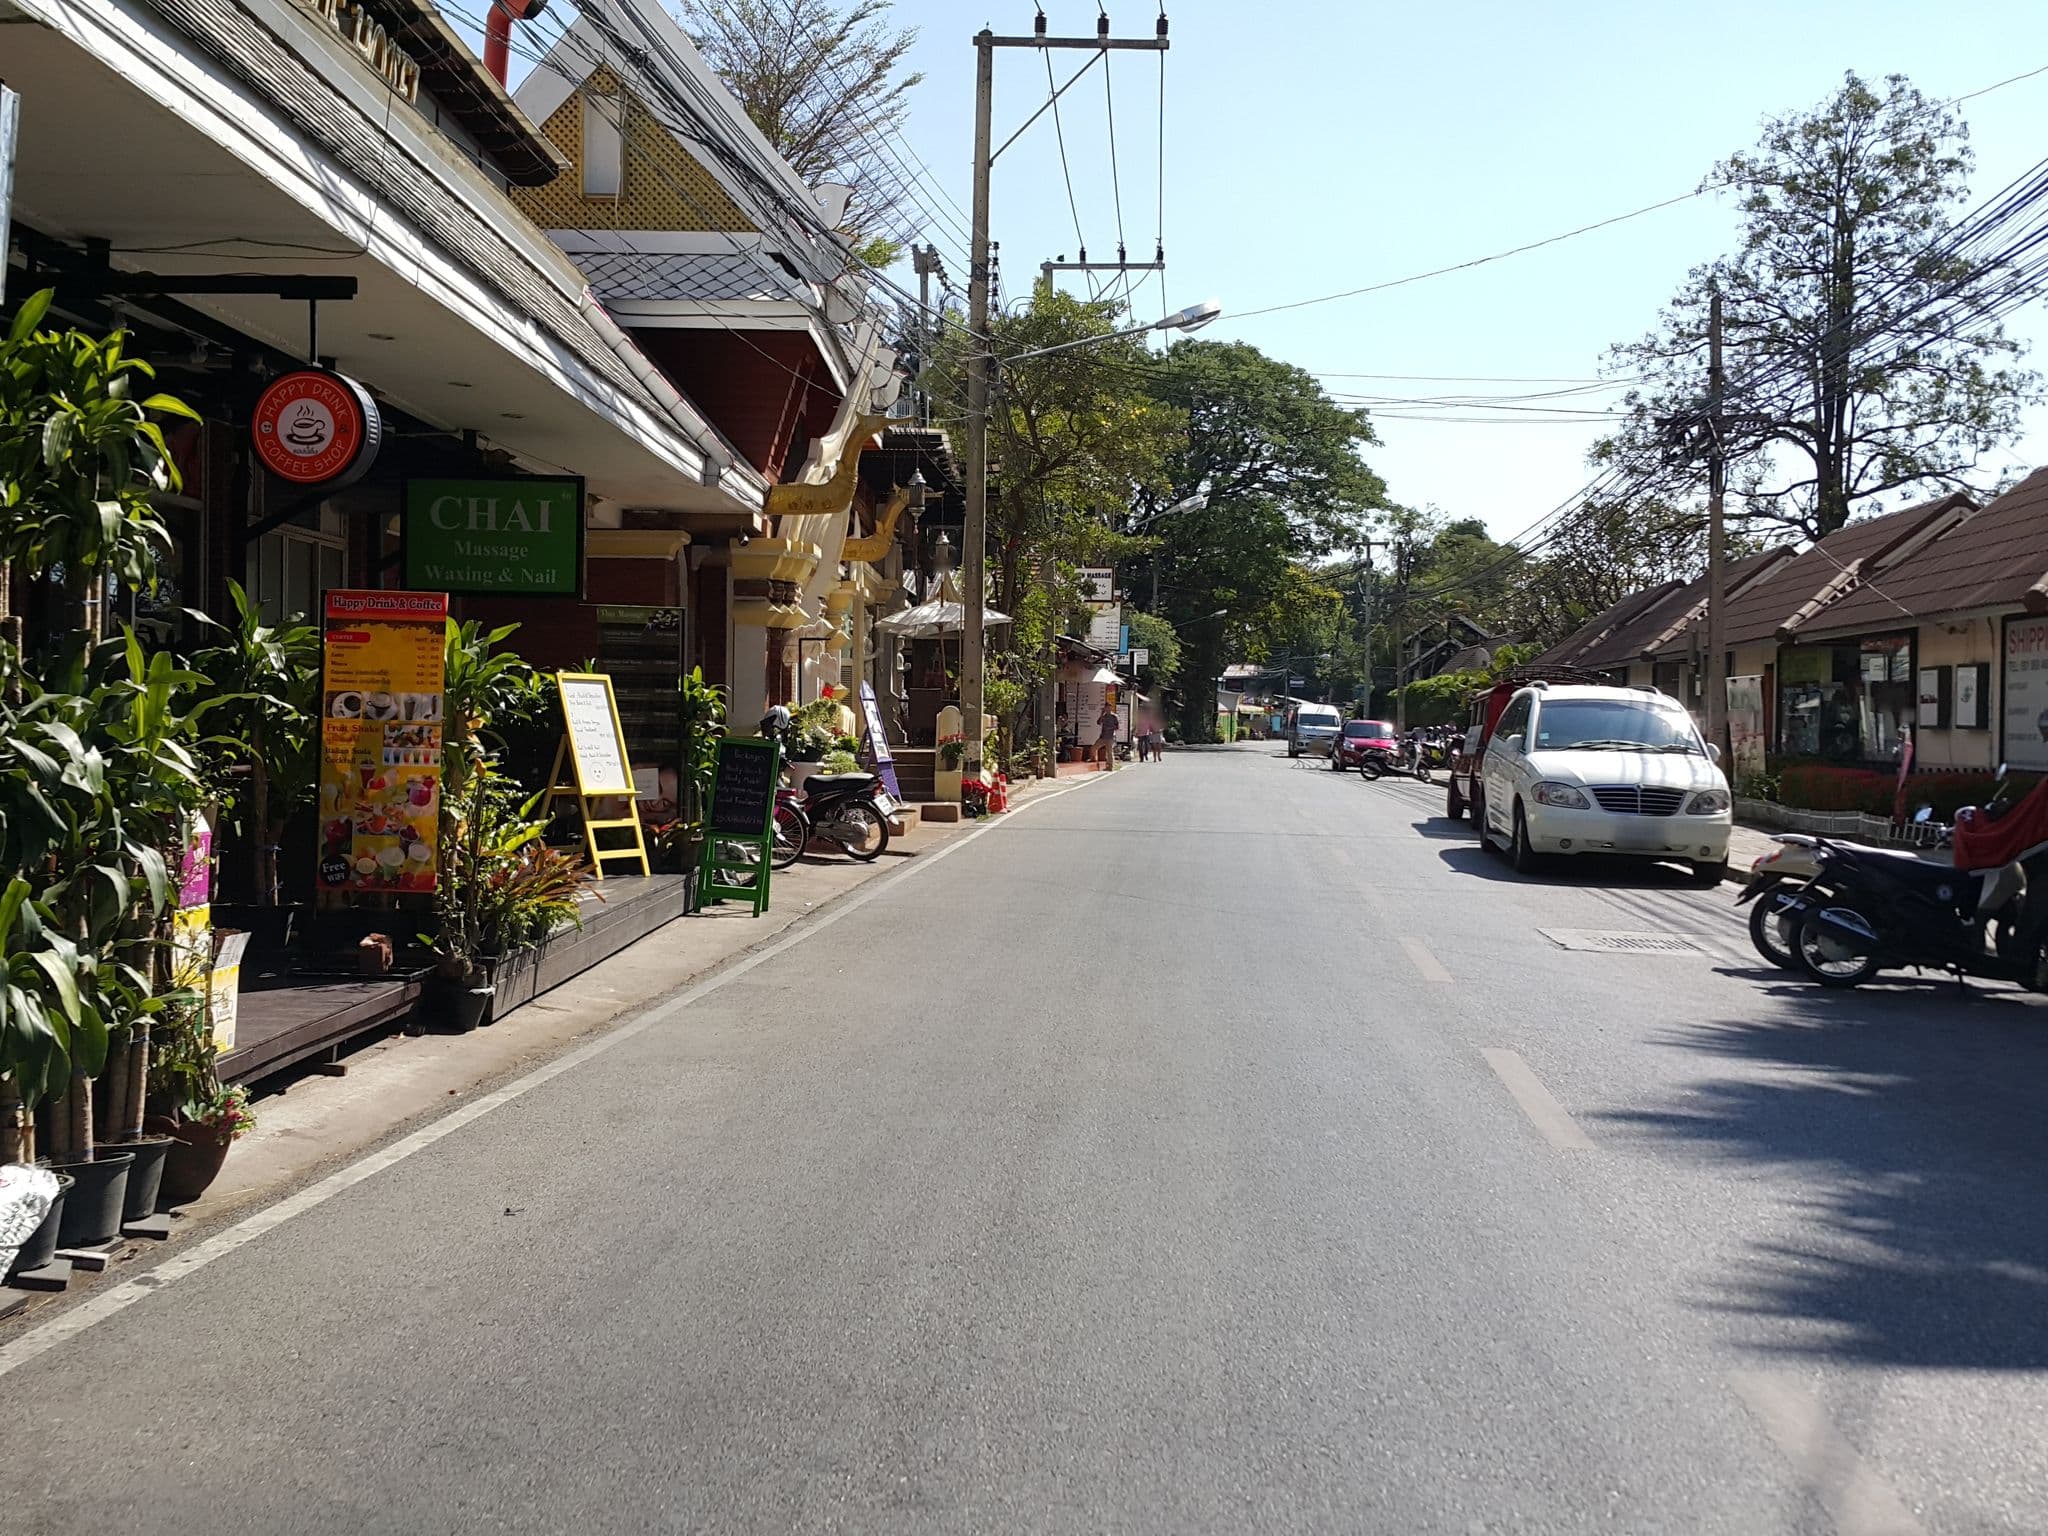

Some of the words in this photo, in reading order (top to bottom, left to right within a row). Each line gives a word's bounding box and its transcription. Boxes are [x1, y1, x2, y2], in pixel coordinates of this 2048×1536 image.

[264, 382, 305, 417] HAPPY
[312, 383, 348, 419] DRINK
[264, 439, 309, 473] COFFEE
[314, 439, 345, 472] SHOP
[429, 495, 552, 533] CHAI
[454, 540, 529, 561] Massage
[425, 564, 493, 584] Waxing
[498, 567, 513, 582] &
[521, 568, 557, 584] Nail
[333, 595, 366, 611] Happy
[367, 596, 398, 609] Drink
[398, 598, 407, 609] &
[408, 598, 442, 610] Coffee
[327, 723, 348, 733] Fruit
[322, 862, 346, 873] Free
